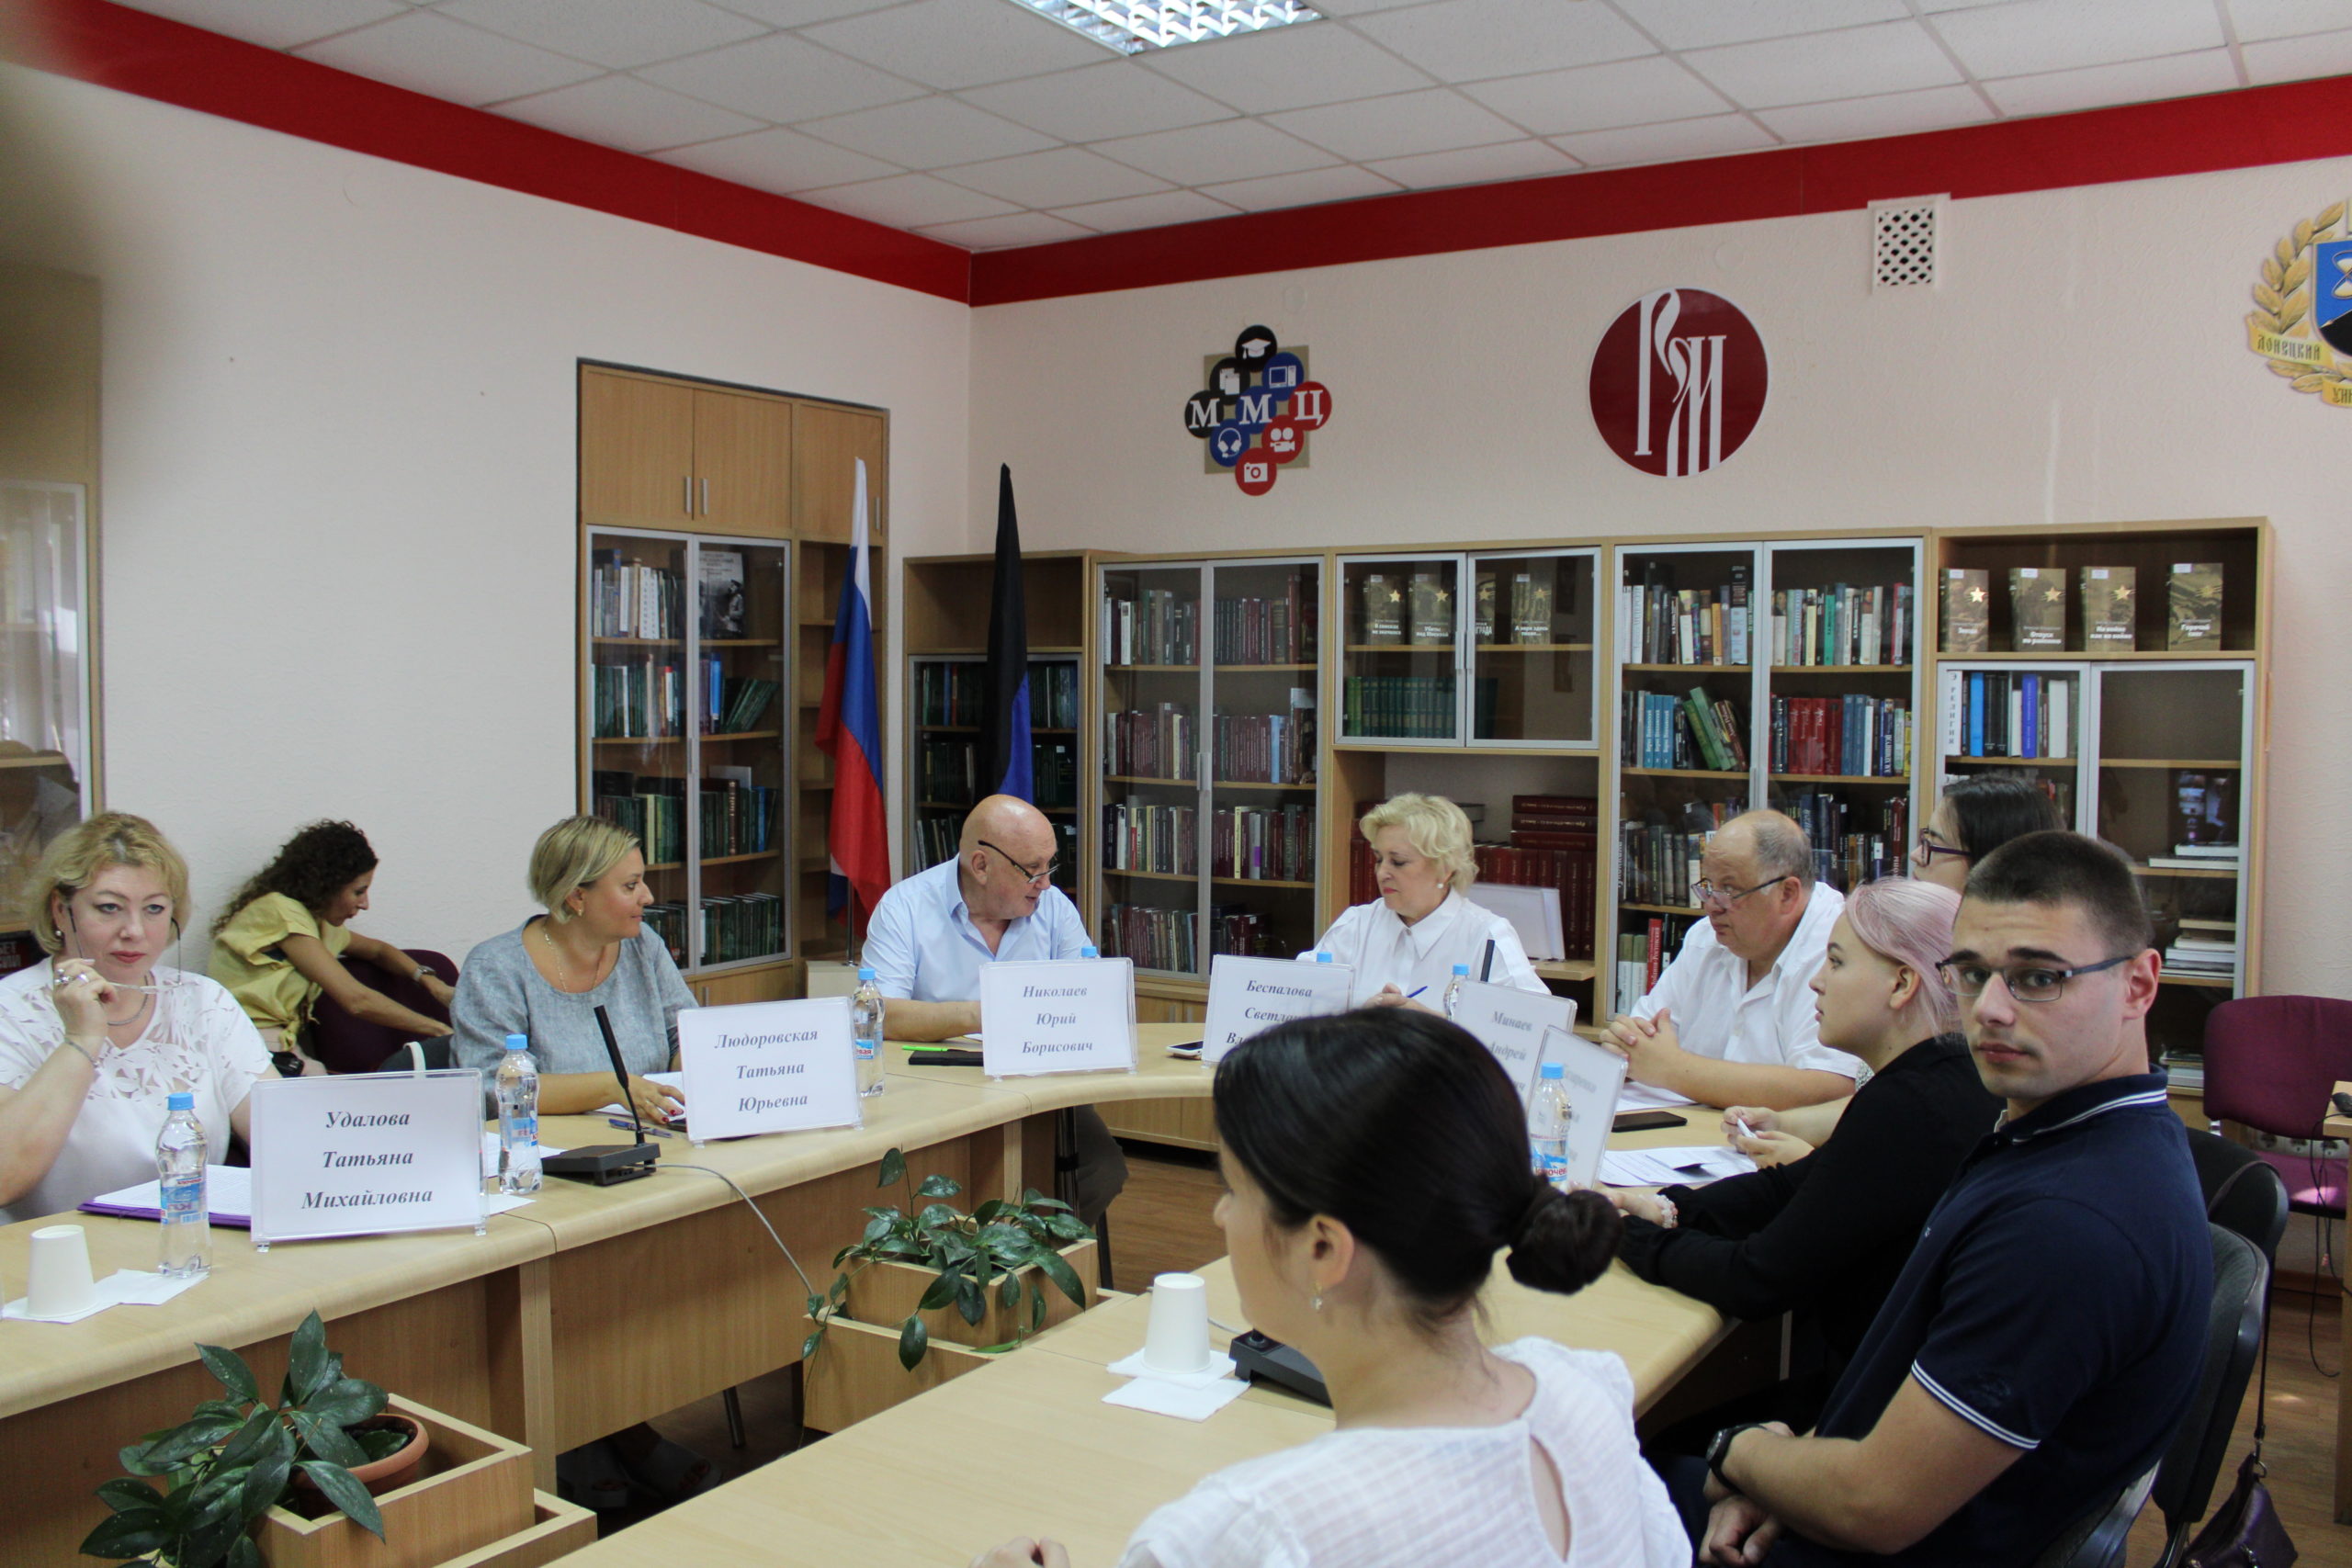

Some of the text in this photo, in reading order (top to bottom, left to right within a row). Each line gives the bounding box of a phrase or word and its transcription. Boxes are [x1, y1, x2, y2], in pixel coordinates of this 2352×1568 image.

[1022, 984, 1088, 999] Николаев
[1246, 979, 1313, 998] Беспалова
[1035, 1012, 1077, 1028] Юрий
[1244, 1007, 1302, 1021] Светла
[1492, 1011, 1533, 1032] Минаев
[714, 1027, 819, 1049] Людоровская
[1022, 1039, 1093, 1055] Борисович
[736, 1060, 805, 1079] Татьяна
[738, 1092, 808, 1114] Юрьевна
[324, 1108, 411, 1131] Удалова
[322, 1147, 413, 1169] Татьяна
[300, 1186, 434, 1212] Михайловна
